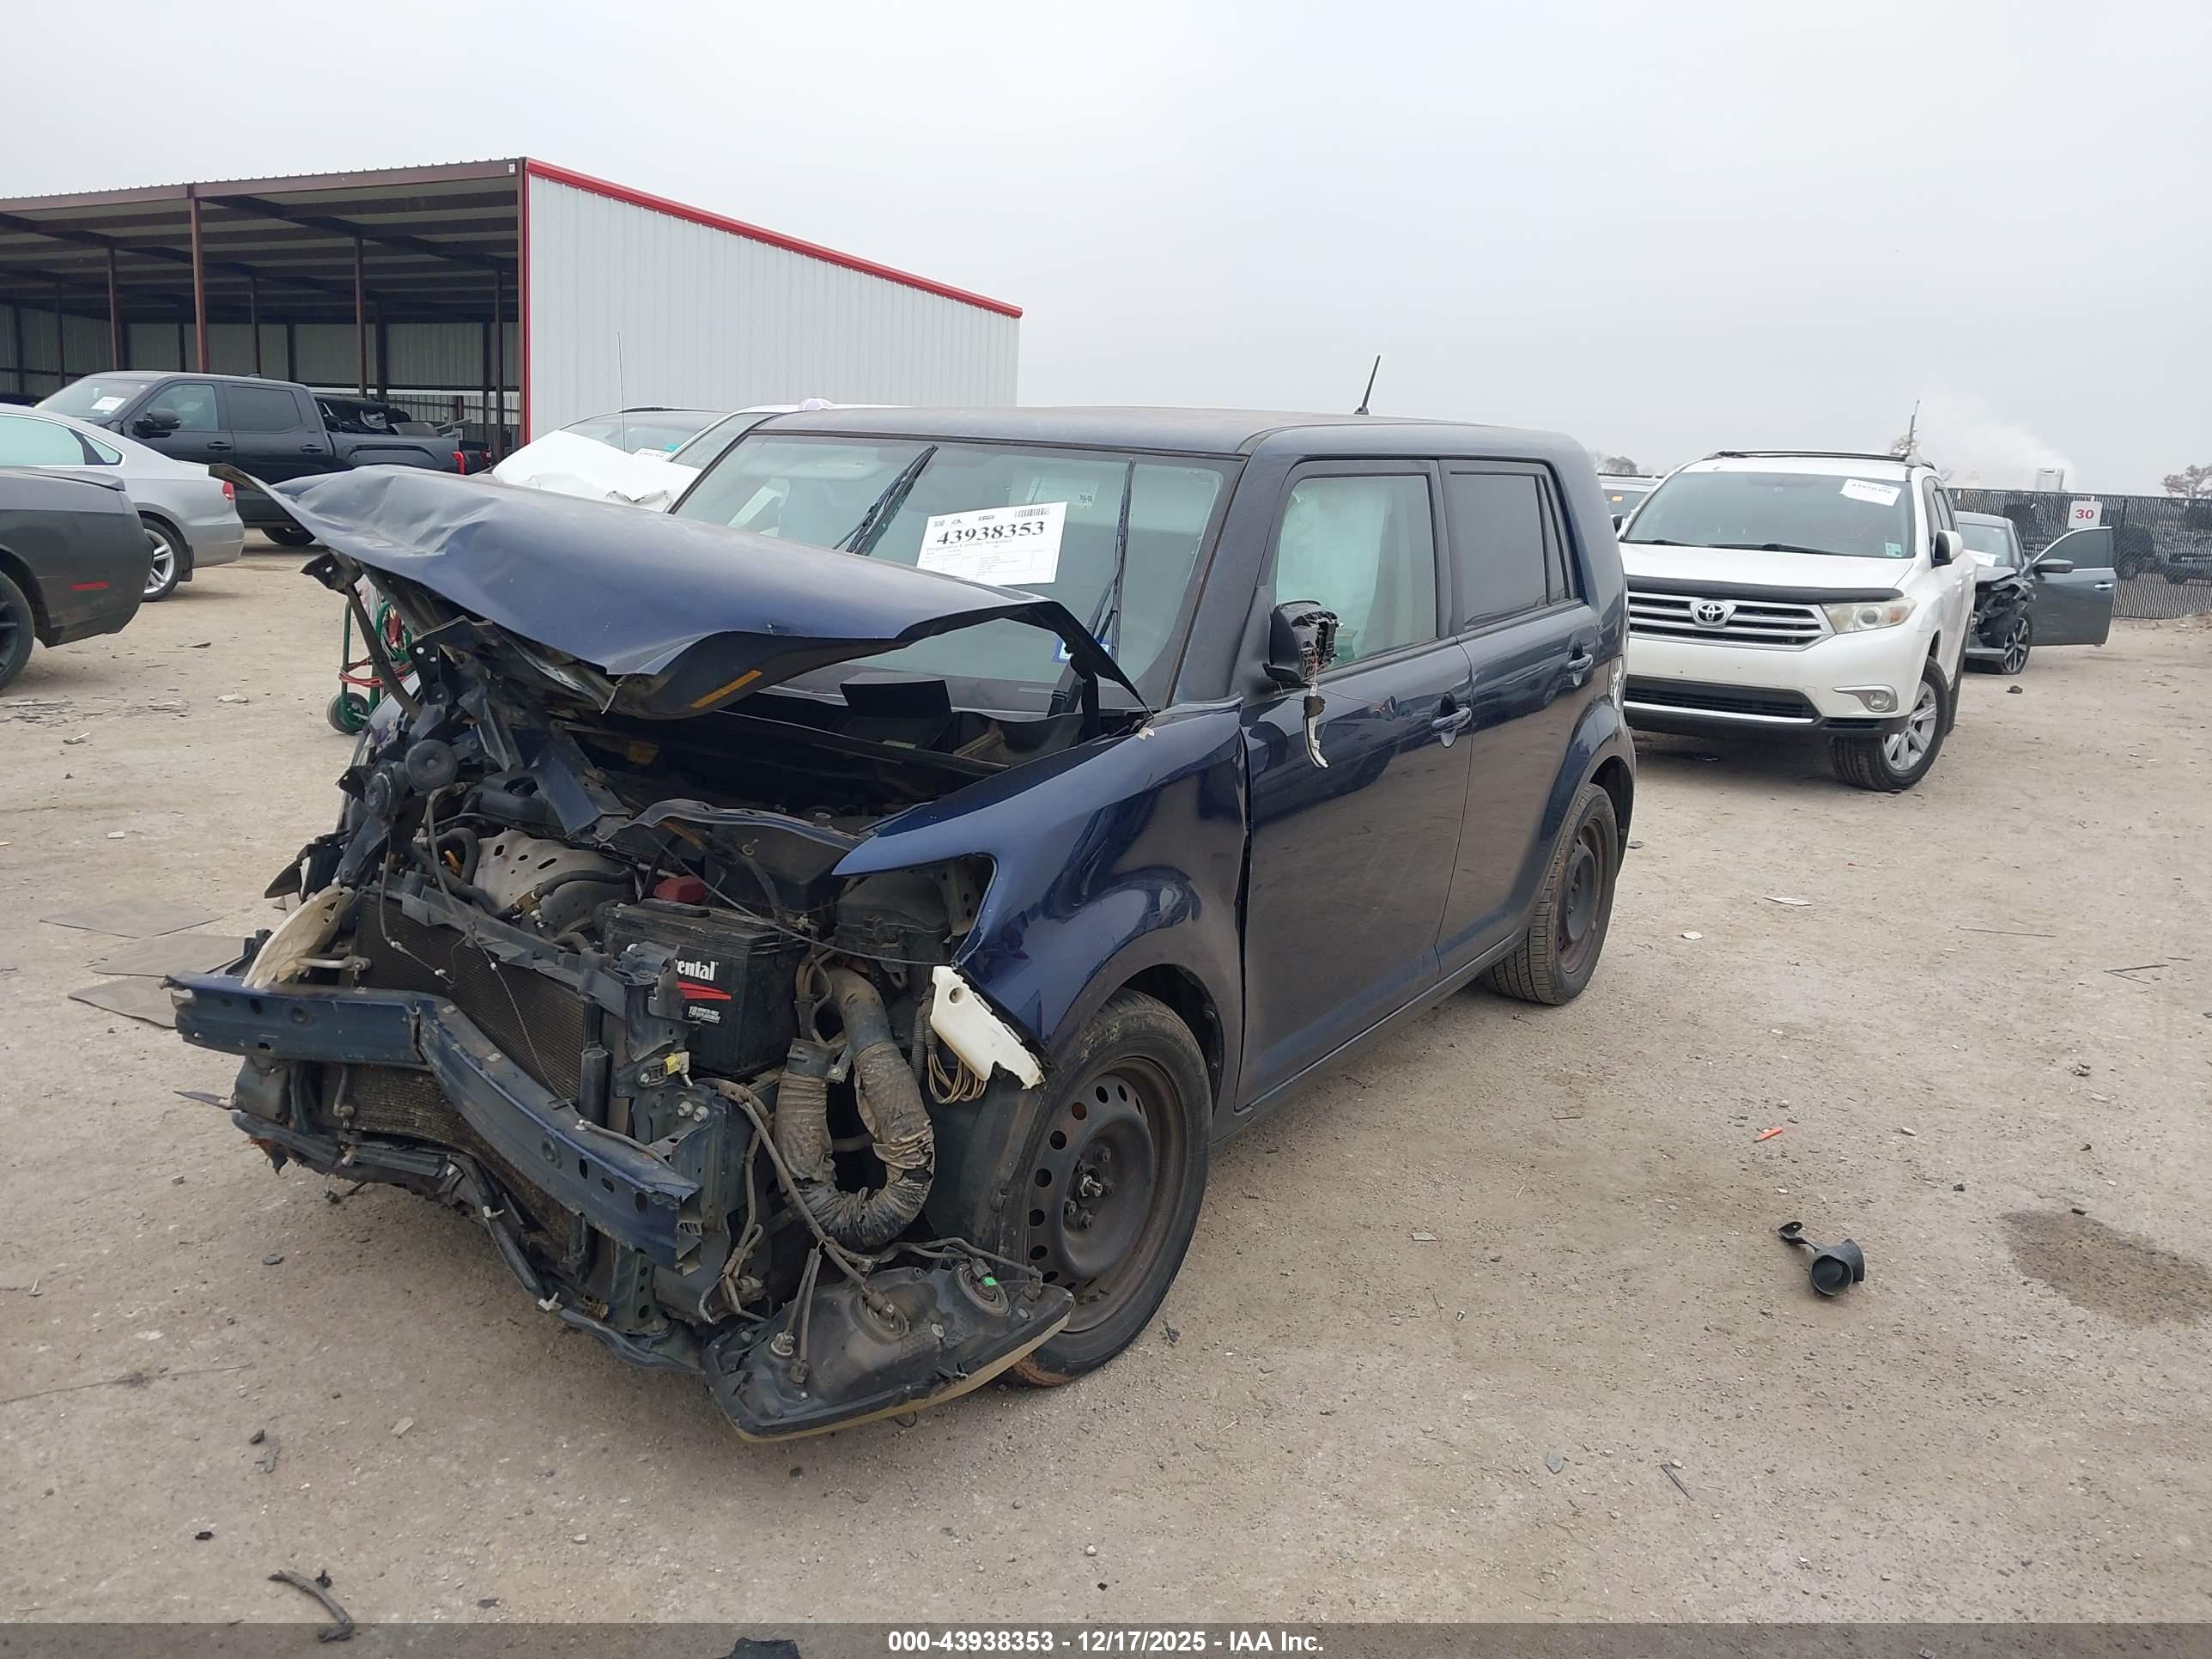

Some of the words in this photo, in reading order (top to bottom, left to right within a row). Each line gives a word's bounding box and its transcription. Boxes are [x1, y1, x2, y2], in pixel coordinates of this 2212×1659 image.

[2075, 508, 2094, 520] 30
[936, 520, 1044, 544] 43938353
[674, 958, 716, 981] ental
